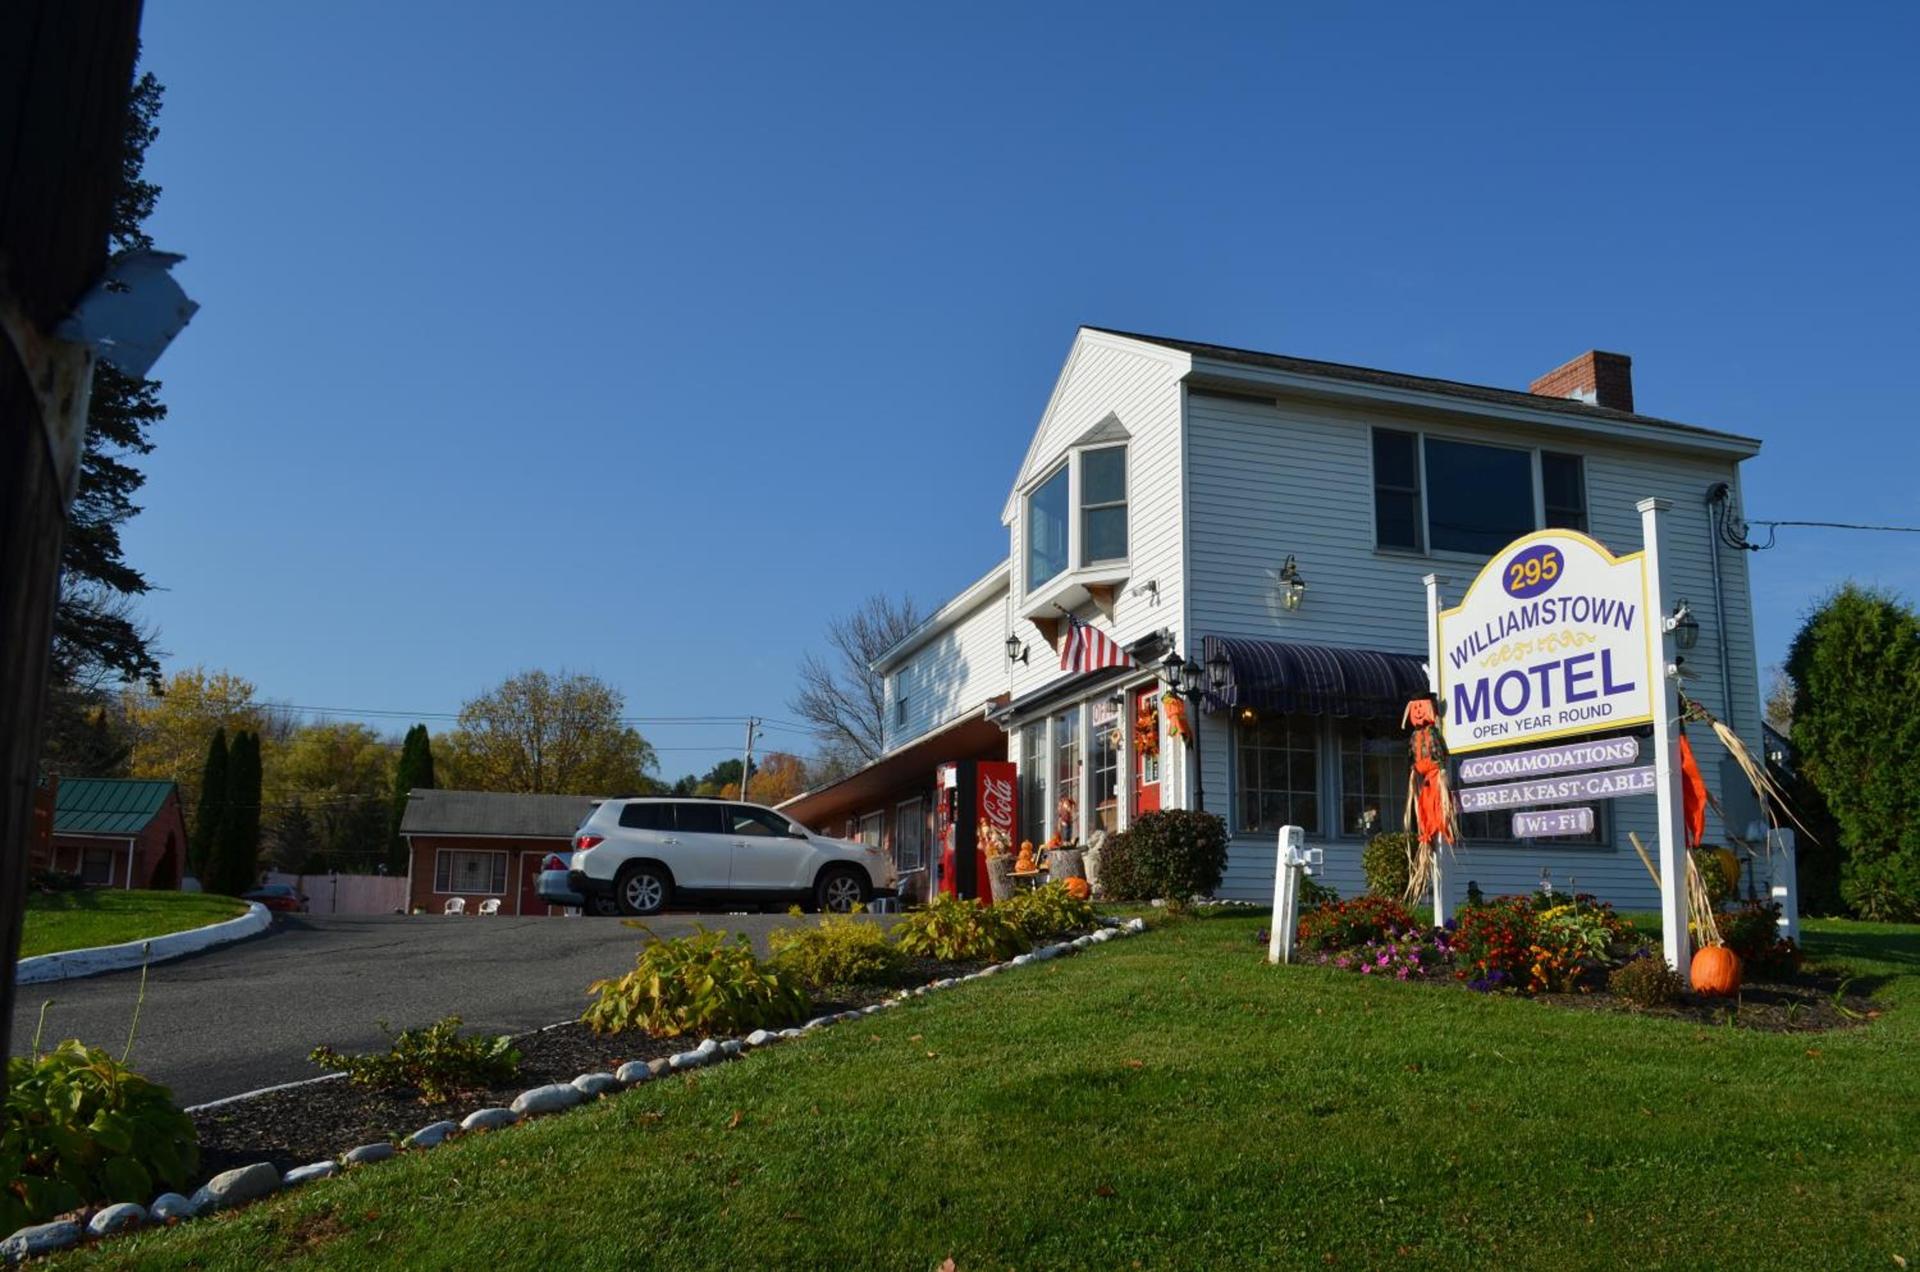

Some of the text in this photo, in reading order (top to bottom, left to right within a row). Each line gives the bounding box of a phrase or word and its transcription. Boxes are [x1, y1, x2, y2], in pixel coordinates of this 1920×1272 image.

[1510, 552, 1559, 591] 295
[1450, 596, 1635, 669] WILLIAMSTOWN
[1454, 648, 1635, 726] MOTEL
[1473, 703, 1613, 739] OPEN YEAR ROUND
[1462, 742, 1634, 778] ACCOMMODATIONS
[1587, 771, 1655, 794] CABLE
